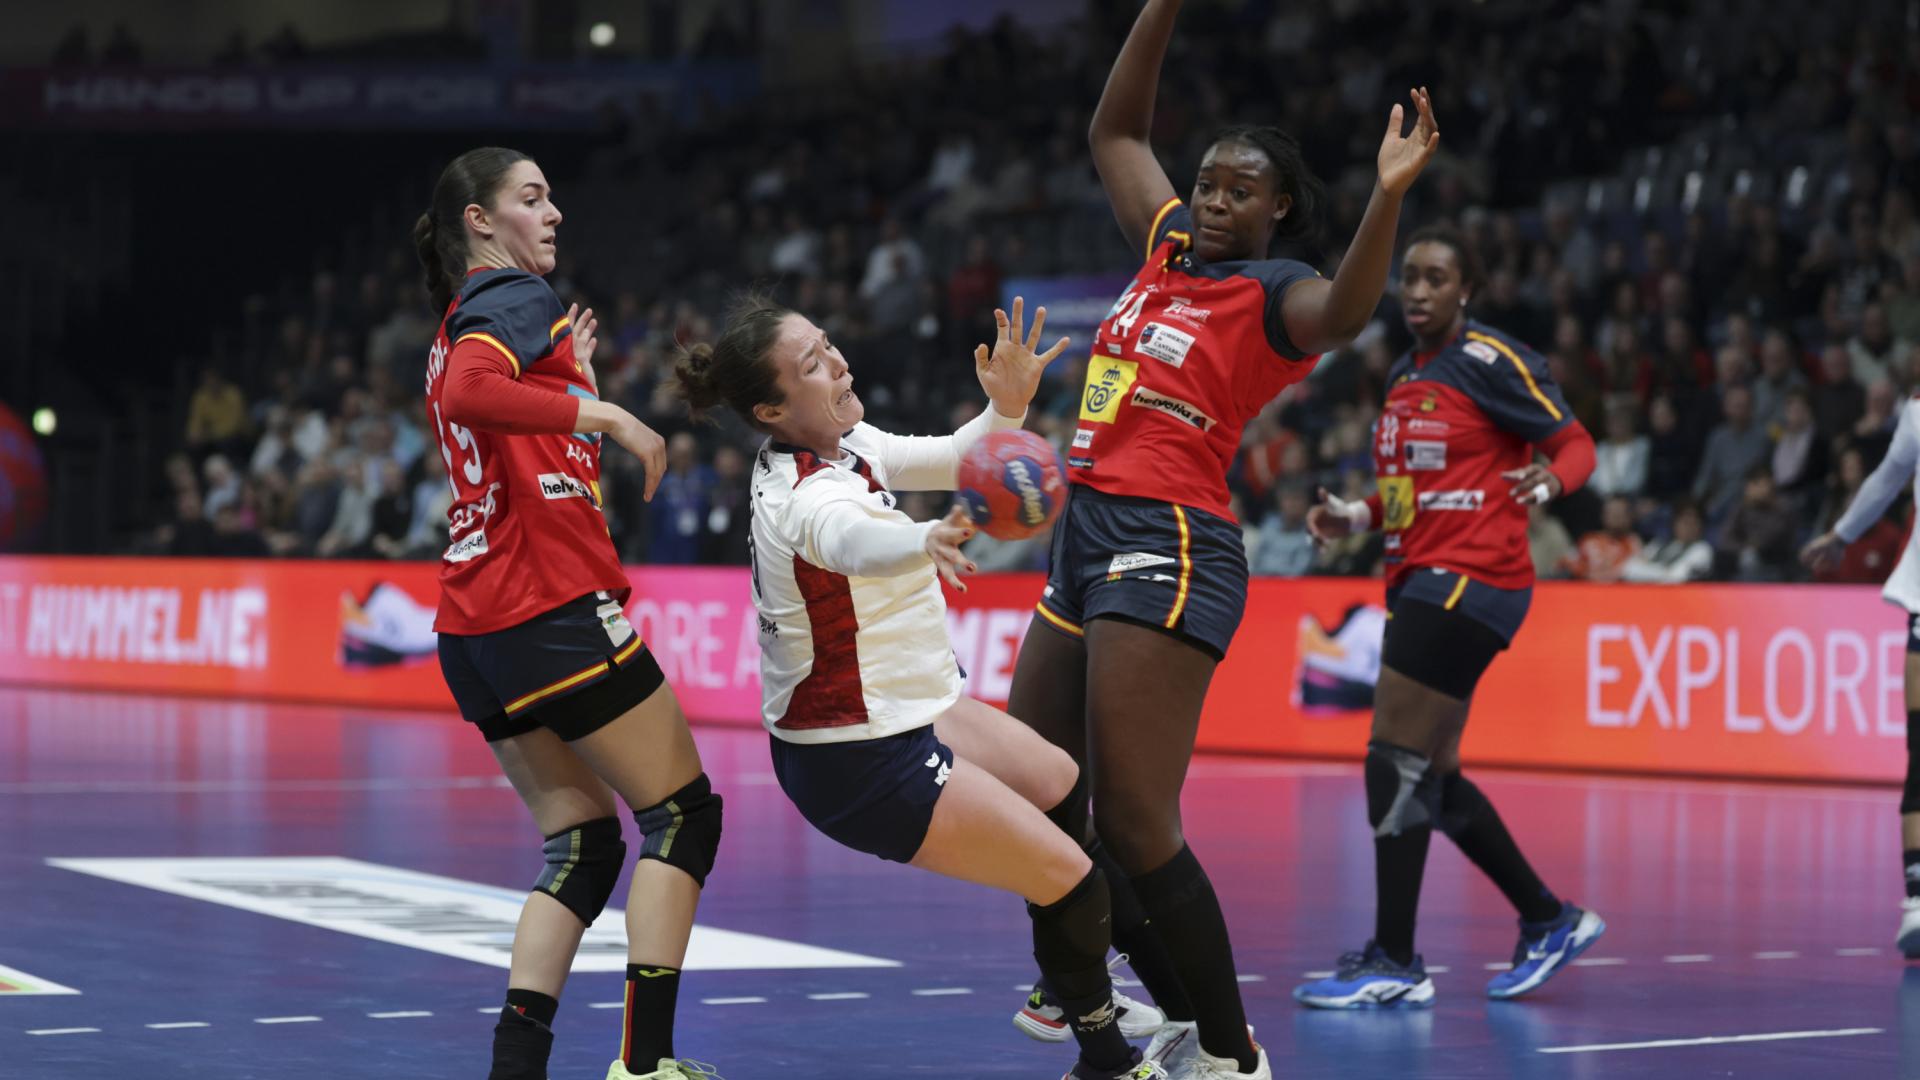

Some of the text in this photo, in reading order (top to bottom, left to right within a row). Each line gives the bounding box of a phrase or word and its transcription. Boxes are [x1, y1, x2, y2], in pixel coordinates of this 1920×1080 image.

[46, 79, 257, 112] HANDS
[269, 79, 354, 112] UP
[371, 79, 497, 112] FOR
[1134, 392, 1191, 420] helvetia
[1586, 624, 1906, 738] EXPLORE
